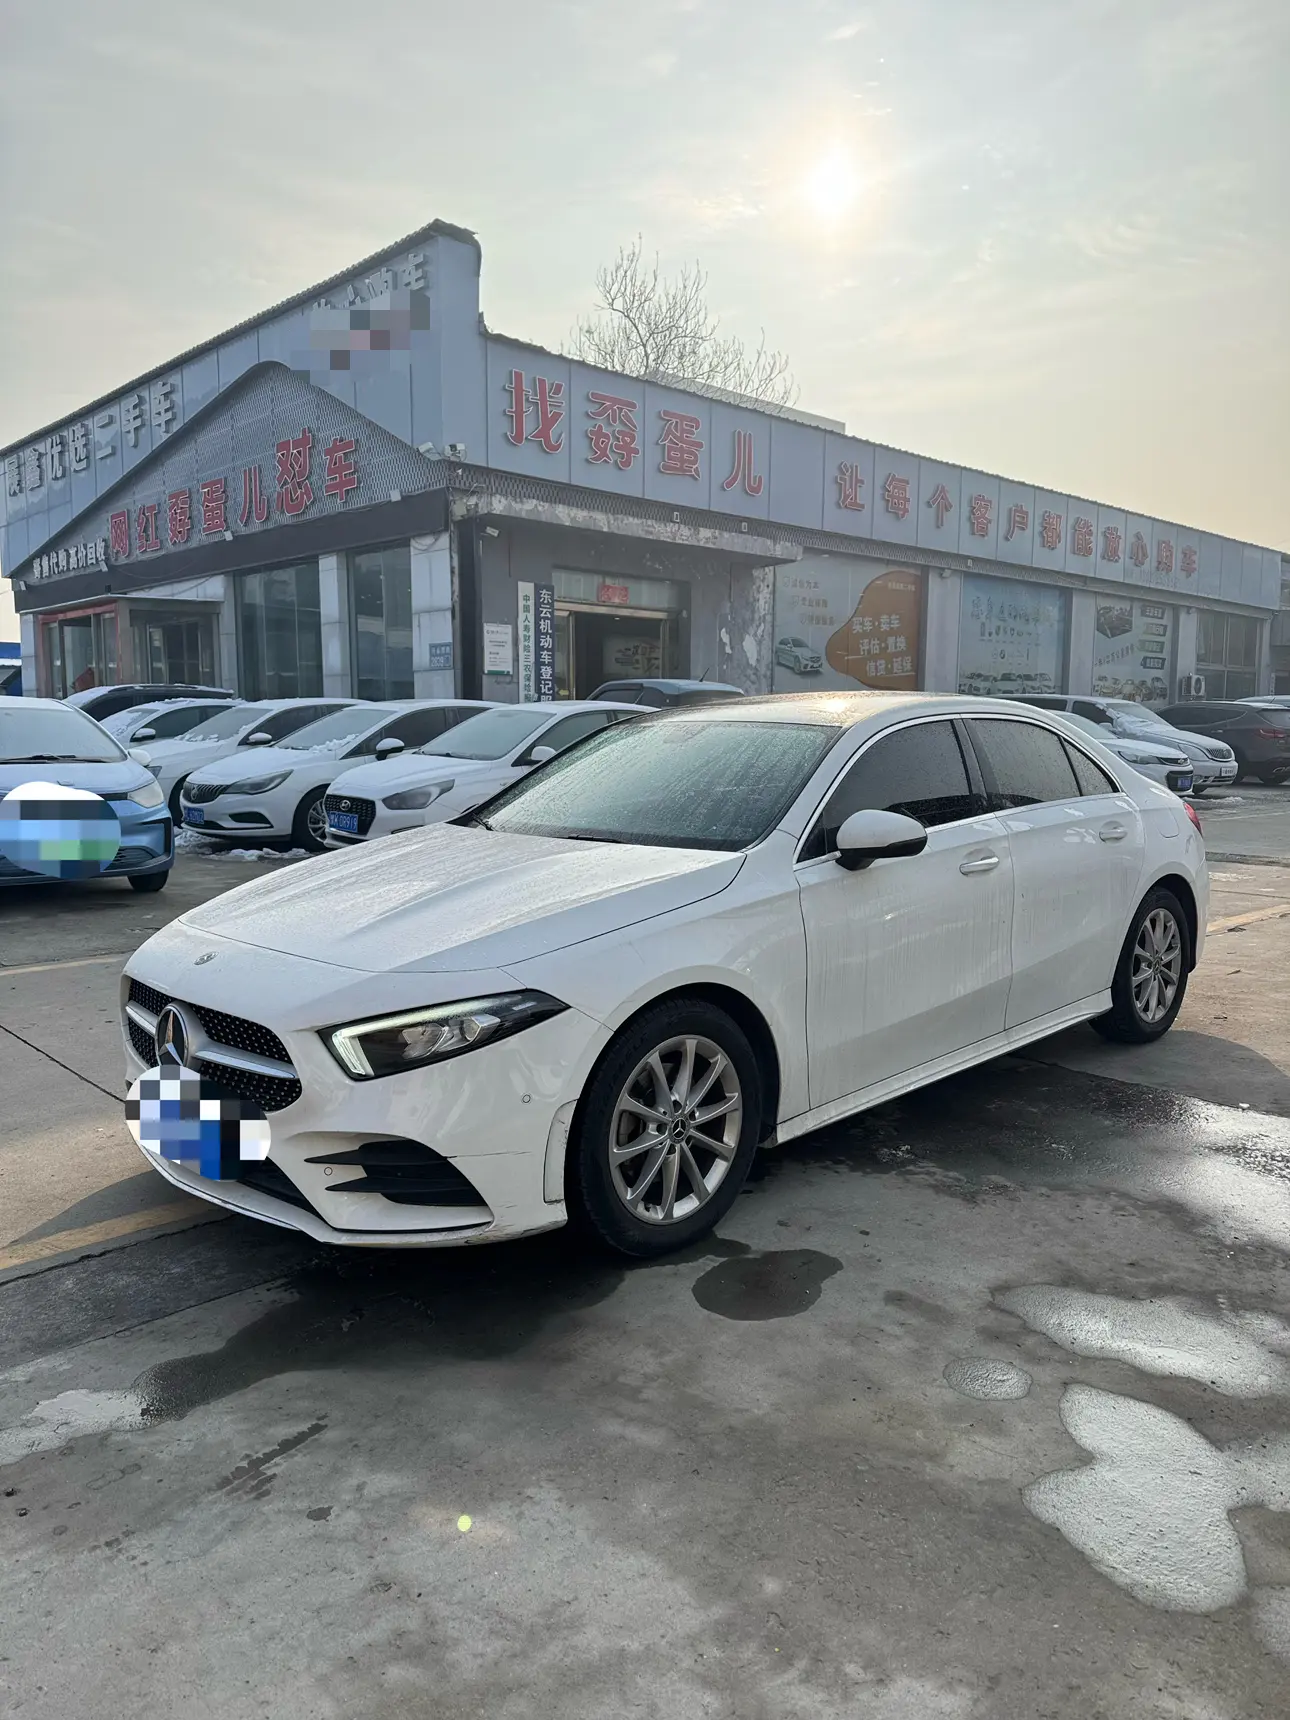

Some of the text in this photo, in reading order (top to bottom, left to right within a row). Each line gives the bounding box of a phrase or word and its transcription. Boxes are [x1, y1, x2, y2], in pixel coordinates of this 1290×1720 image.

[110, 427, 358, 559] 网红孬蛋儿怼车
[505, 368, 1198, 579] 找孬蛋儿 让每个客户都能放心购车
